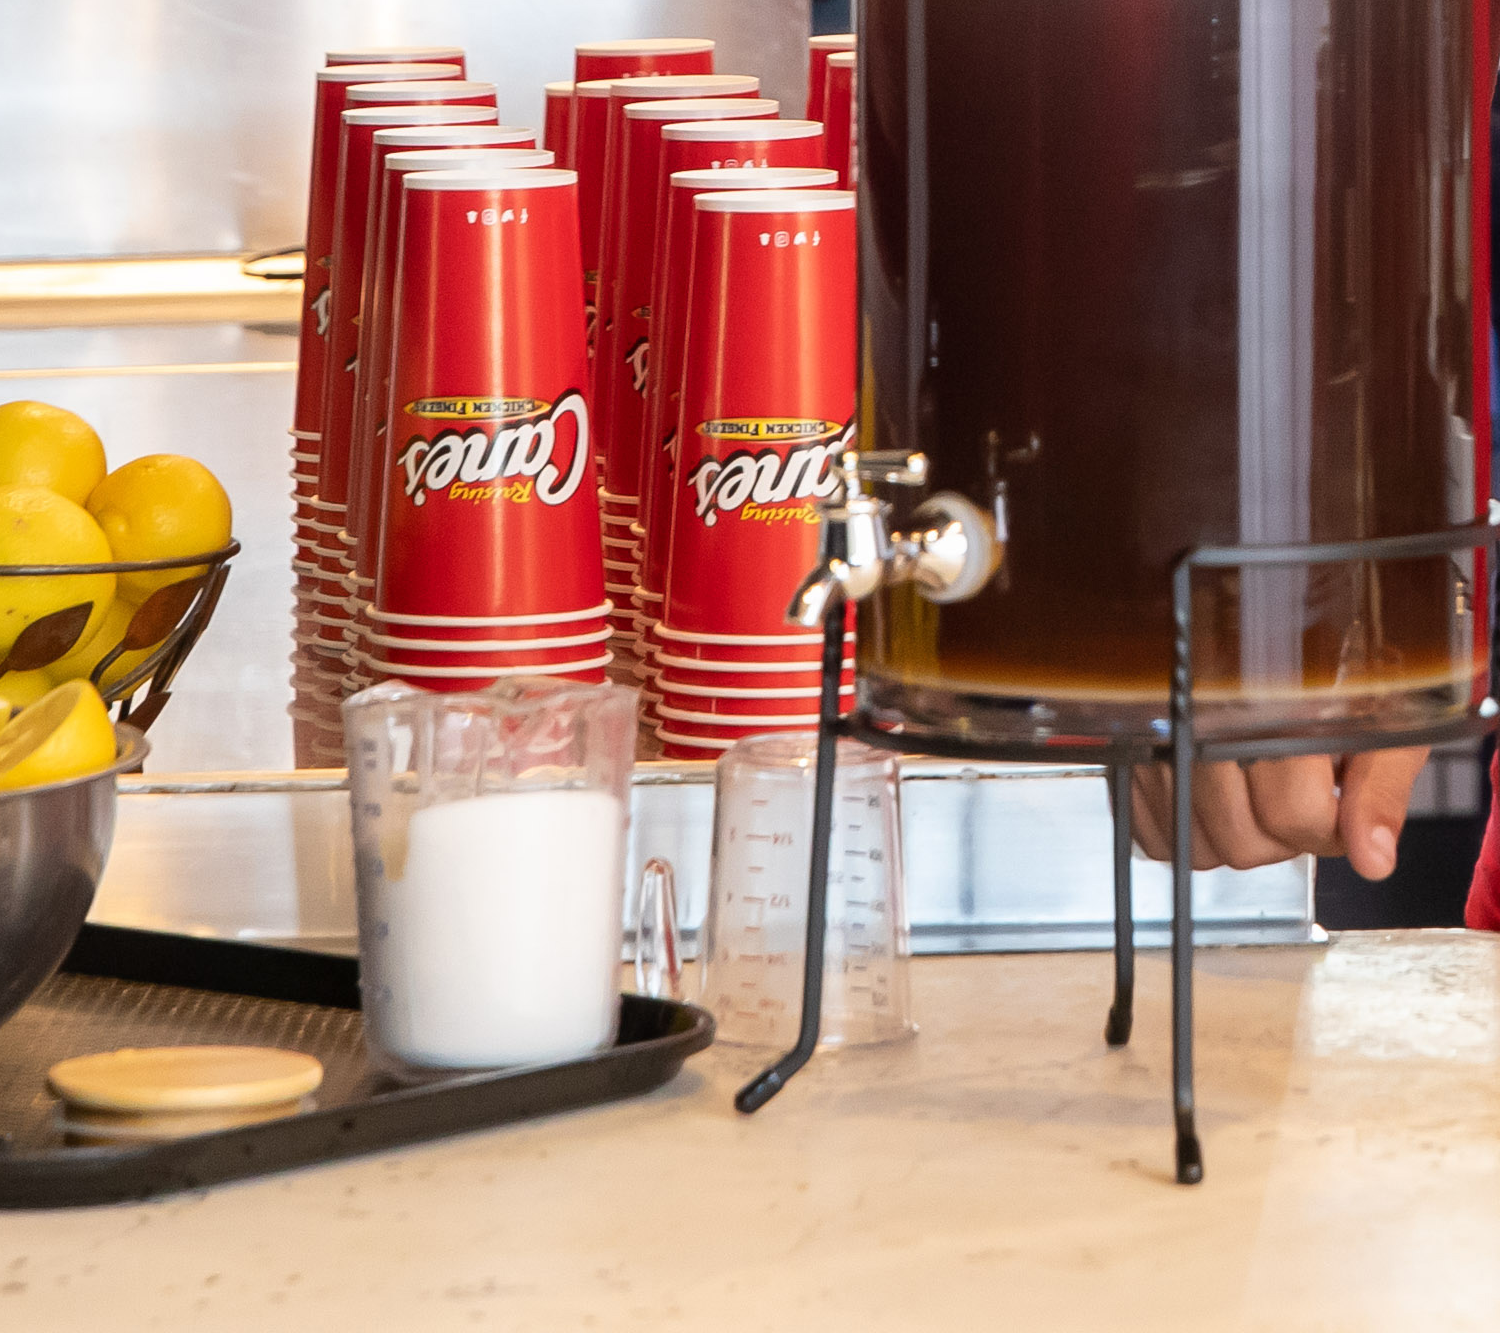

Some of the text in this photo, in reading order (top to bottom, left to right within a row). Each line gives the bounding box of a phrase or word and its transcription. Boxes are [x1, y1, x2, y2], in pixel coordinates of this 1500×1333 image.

[472, 399, 536, 414] CHICKEN
[765, 421, 828, 435] CHICKEN
[396, 390, 590, 507] Cane's
[687, 418, 857, 528] ane's
[449, 481, 534, 506] Raising
